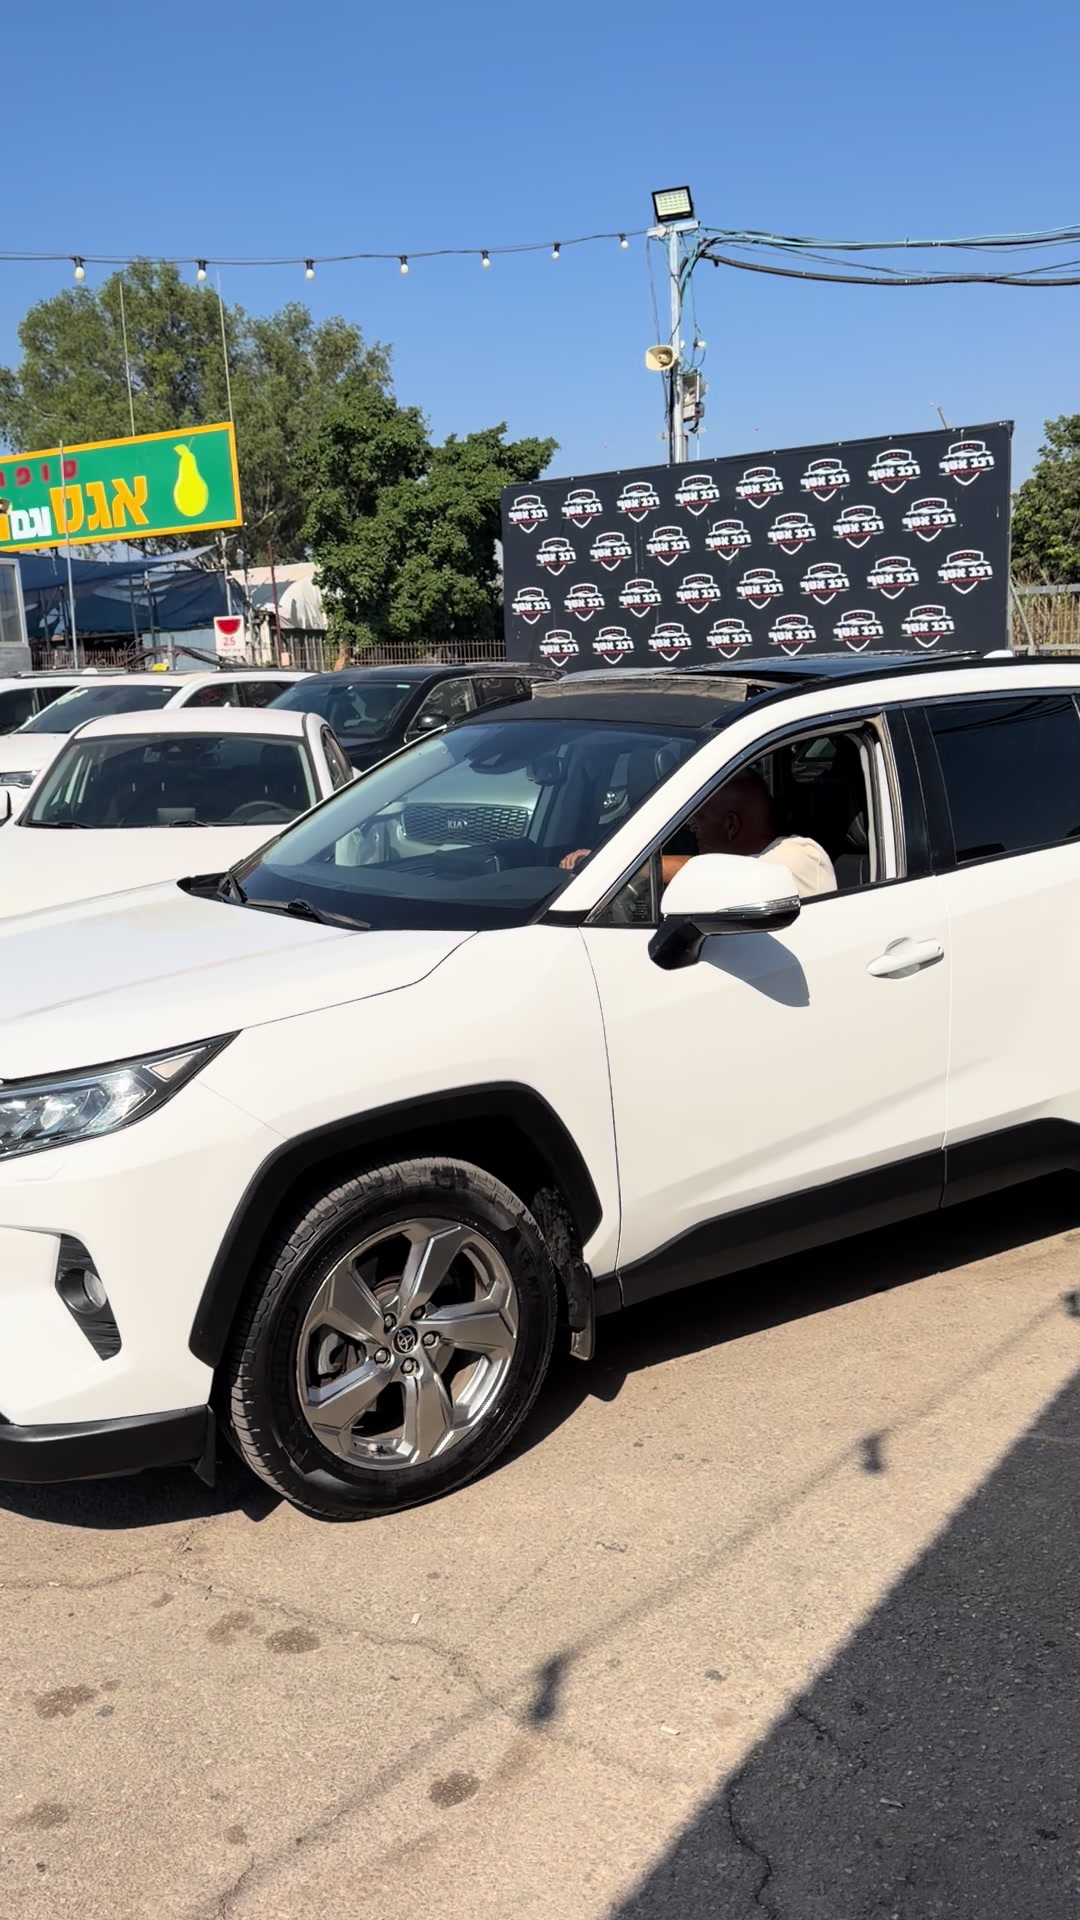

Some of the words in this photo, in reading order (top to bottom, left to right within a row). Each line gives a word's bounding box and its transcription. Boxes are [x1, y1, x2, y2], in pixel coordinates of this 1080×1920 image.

[970, 455, 994, 467] רכב
[897, 464, 920, 476] רכב
[828, 474, 850, 485] רכב
[762, 481, 784, 493] רכב
[700, 489, 720, 500] רכב
[49, 475, 149, 534] אגס
[641, 496, 660, 506] רכב
[531, 508, 548, 518] רכב
[584, 502, 602, 513] רכב
[932, 513, 956, 525] רכב
[862, 520, 884, 531] רכב
[731, 533, 752, 544] רכב
[795, 527, 816, 539] רכב
[613, 545, 632, 556] רכב
[671, 540, 690, 550] רכב
[558, 550, 576, 560] רכב
[896, 571, 920, 582] רכב
[968, 565, 992, 577] רכב
[762, 582, 784, 593] רכב
[828, 577, 850, 589] רכב
[643, 592, 662, 602] רכב
[701, 587, 720, 598] רכב
[534, 600, 552, 610] רכב
[587, 596, 606, 606] רכב
[861, 624, 884, 636] רכב
[932, 620, 956, 631] רכב
[732, 632, 752, 642] רכב
[795, 628, 816, 639] רכב
[223, 636, 236, 646] 25
[616, 639, 634, 649] רכב
[672, 636, 692, 646] רכב
[562, 643, 580, 653] רכב
[447, 820, 463, 829] KIA
